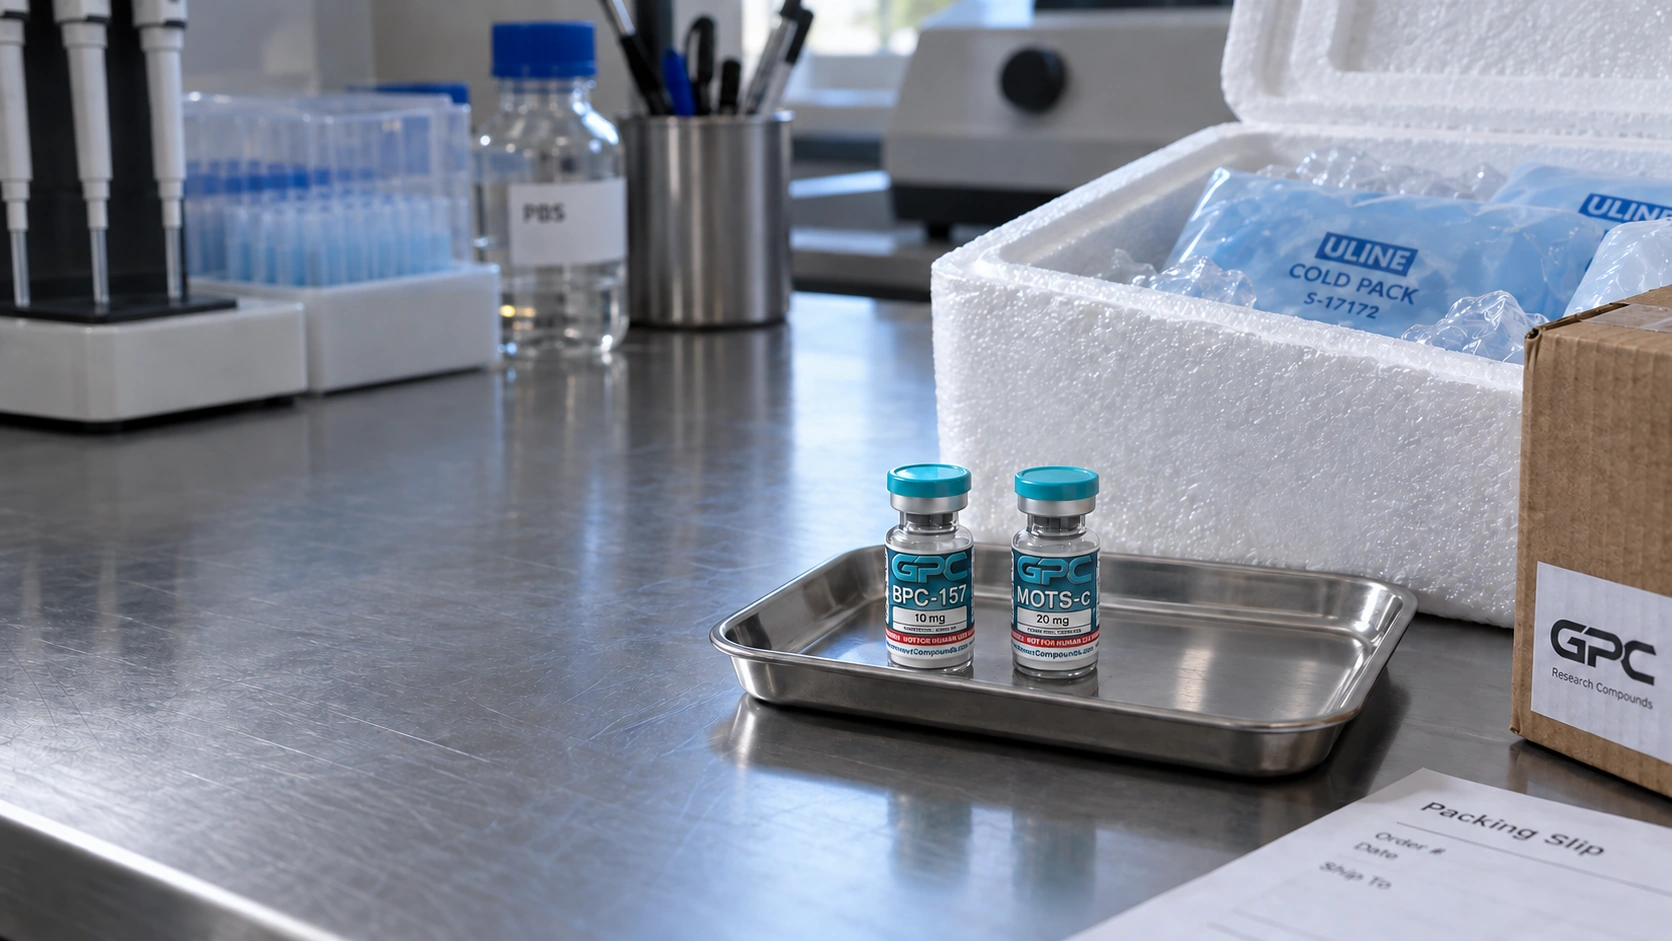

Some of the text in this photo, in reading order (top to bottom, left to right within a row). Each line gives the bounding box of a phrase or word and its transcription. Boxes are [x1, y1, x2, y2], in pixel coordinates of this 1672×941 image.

[523, 202, 566, 223] PBS
[1324, 237, 1411, 270] ULINE
[1289, 263, 1419, 305] COLD PACK
[1303, 292, 1379, 319] S-17172
[892, 552, 967, 583] GPC
[1017, 555, 1092, 585] GPC
[892, 584, 966, 606] BPC-157
[915, 613, 945, 624] 10 mg
[1036, 614, 1069, 626] 20 mg
[1550, 619, 1657, 686] GPC
[1551, 667, 1654, 710] Research Compounds
[1375, 832, 1428, 850] Order
[1421, 802, 1605, 858] Packing Slip
[1354, 842, 1398, 860] Date
[1319, 861, 1391, 890] Ship To
